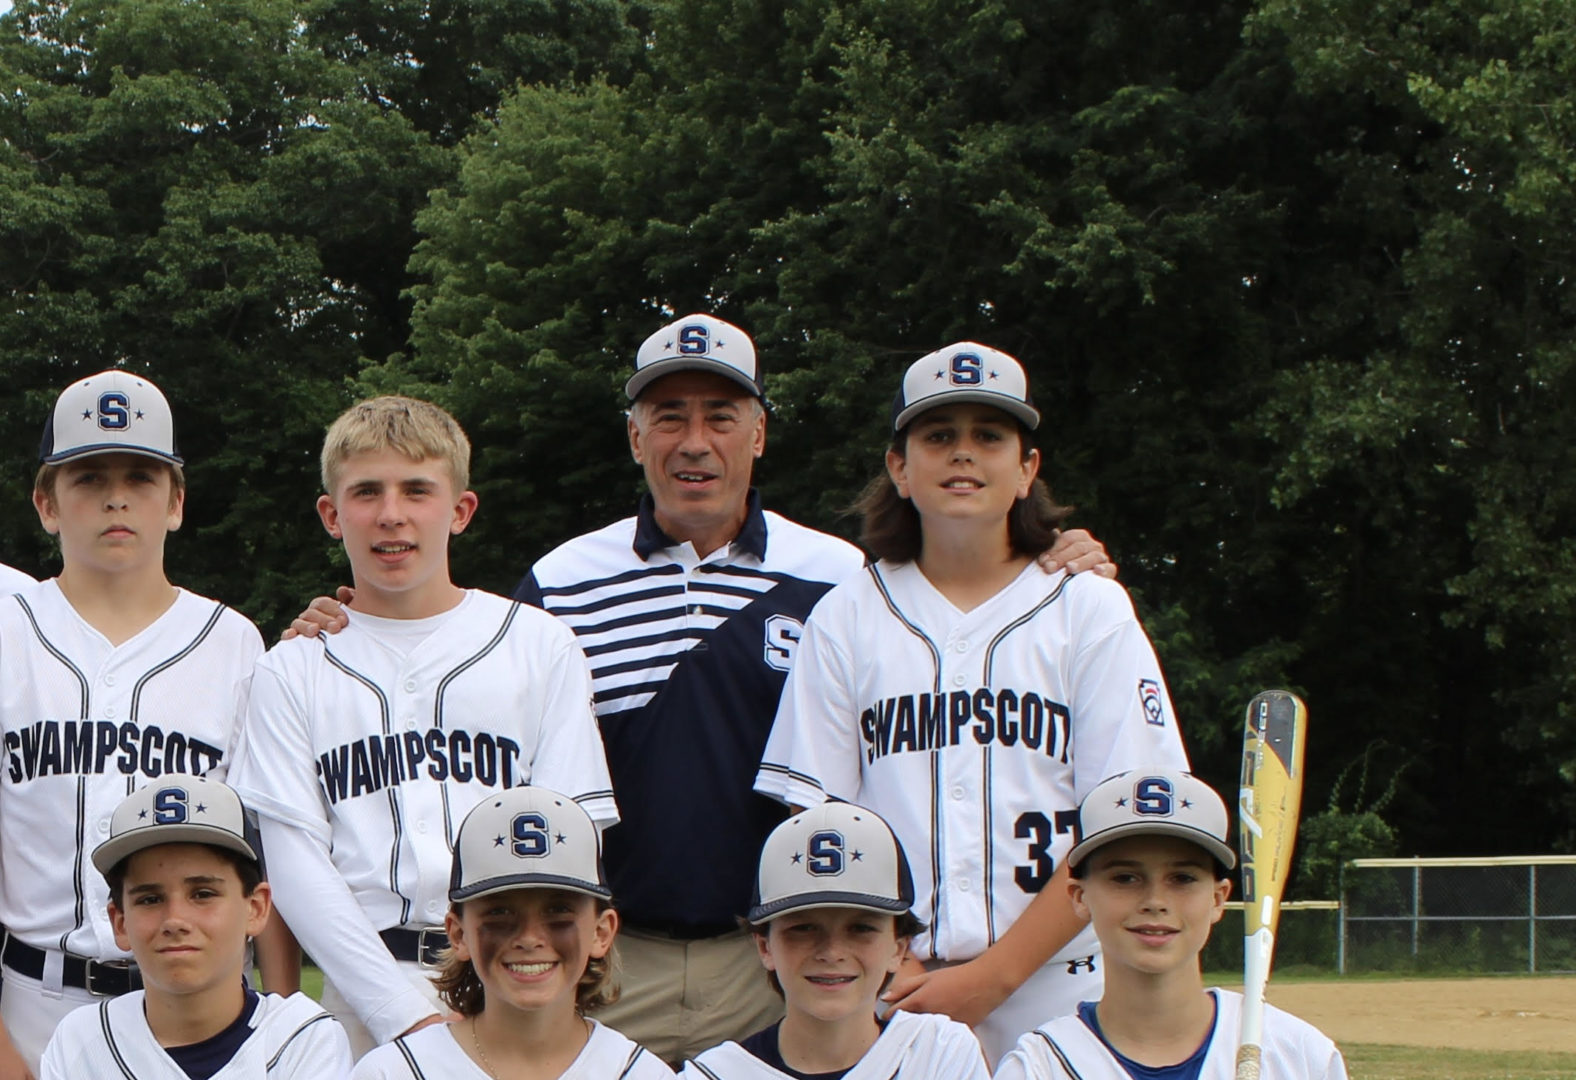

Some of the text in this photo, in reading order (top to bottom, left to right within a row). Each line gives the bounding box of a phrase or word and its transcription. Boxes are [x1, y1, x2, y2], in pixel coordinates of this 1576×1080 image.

[676, 323, 710, 356] S
[949, 352, 984, 388] S
[98, 391, 130, 431] S
[860, 688, 1071, 765] SWAMPSCOTT
[4, 721, 223, 784] SWAMPSCOTT
[315, 728, 519, 805] WAMPSCOT
[152, 787, 190, 826] S
[1133, 776, 1174, 818] S
[511, 811, 551, 858] S
[806, 829, 844, 877] S
